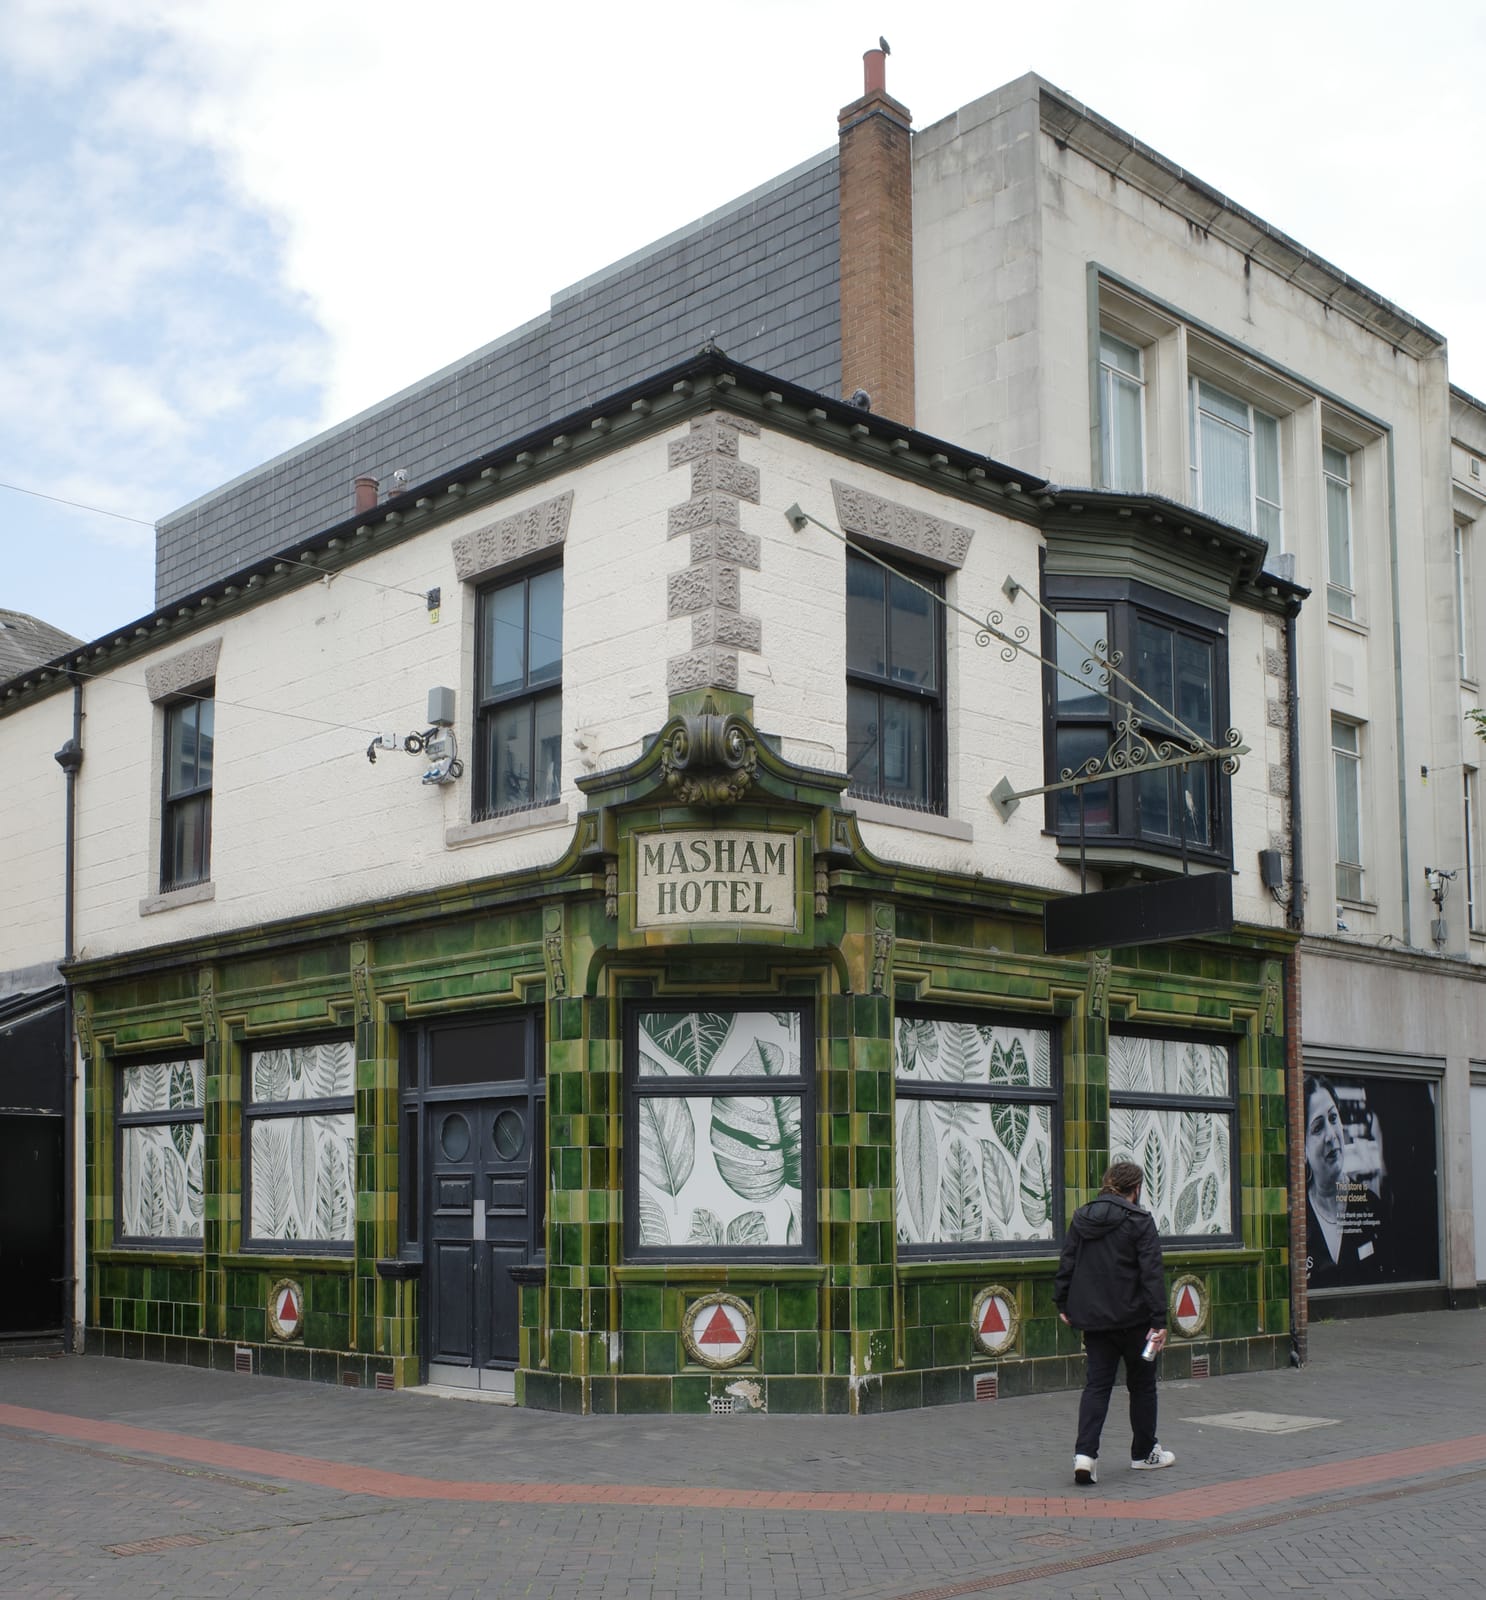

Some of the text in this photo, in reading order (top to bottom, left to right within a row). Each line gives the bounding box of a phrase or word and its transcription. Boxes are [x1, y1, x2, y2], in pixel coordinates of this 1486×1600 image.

[643, 839, 787, 876] MASHAM
[656, 880, 773, 914] HOTEL
[1348, 1182, 1362, 1191] store
